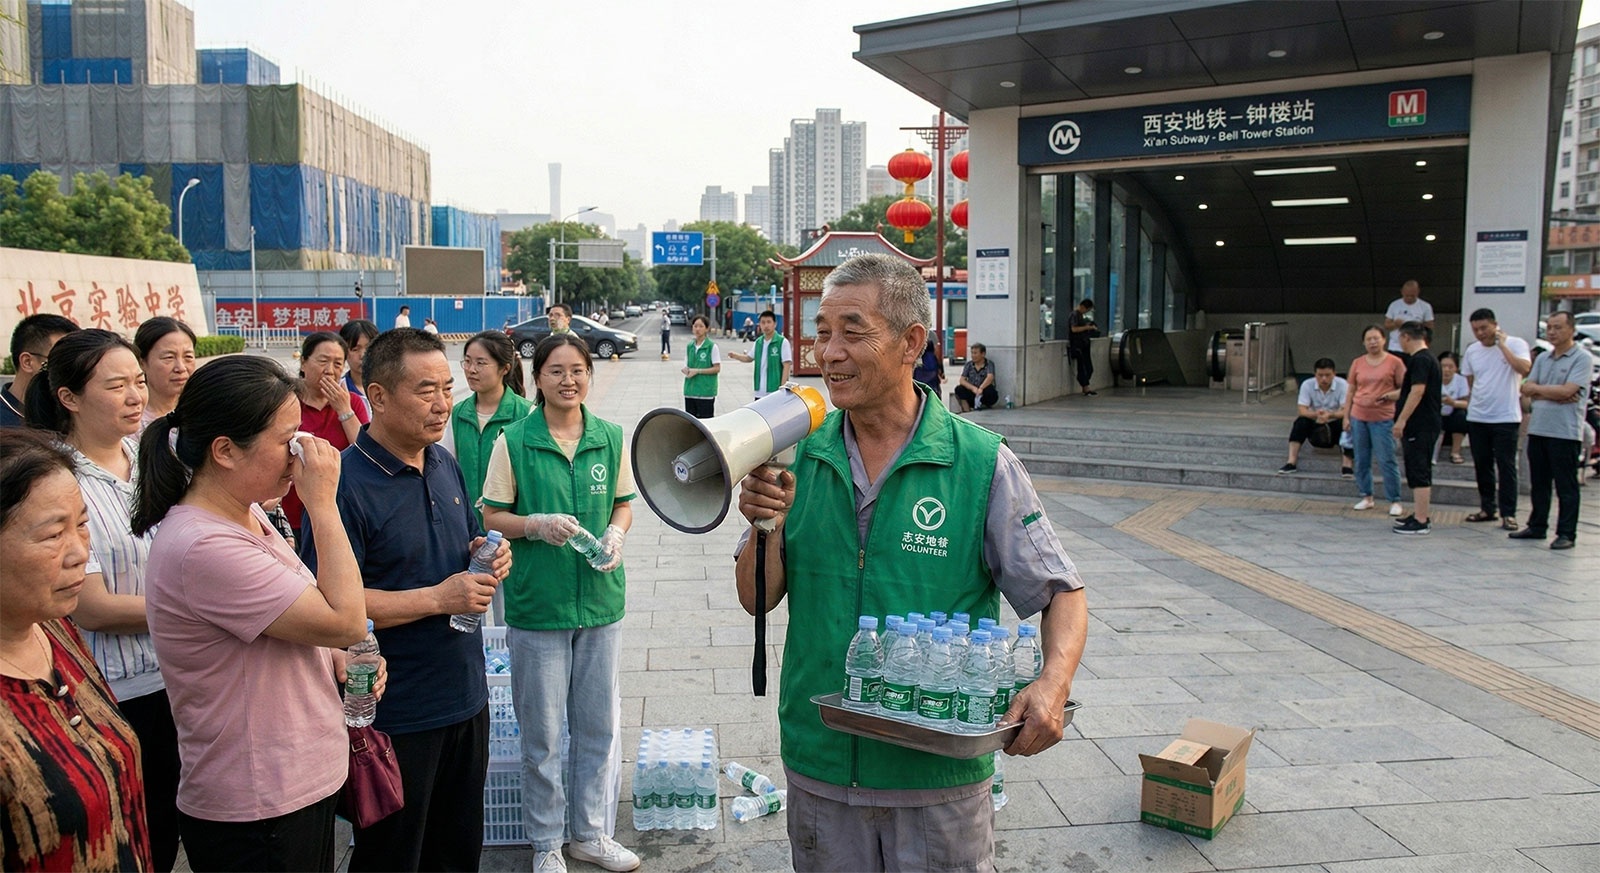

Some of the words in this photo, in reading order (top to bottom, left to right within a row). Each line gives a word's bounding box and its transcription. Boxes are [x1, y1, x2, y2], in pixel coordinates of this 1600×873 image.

[1397, 94, 1418, 114] M
[1143, 137, 1168, 147] Xi'an
[1170, 134, 1209, 146] Subway
[1218, 130, 1239, 142] Bell
[1241, 128, 1273, 140] Tower
[1275, 125, 1314, 137] Station
[16, 280, 186, 331] 北京实验中学
[901, 543, 948, 557] VOLUNTEER
